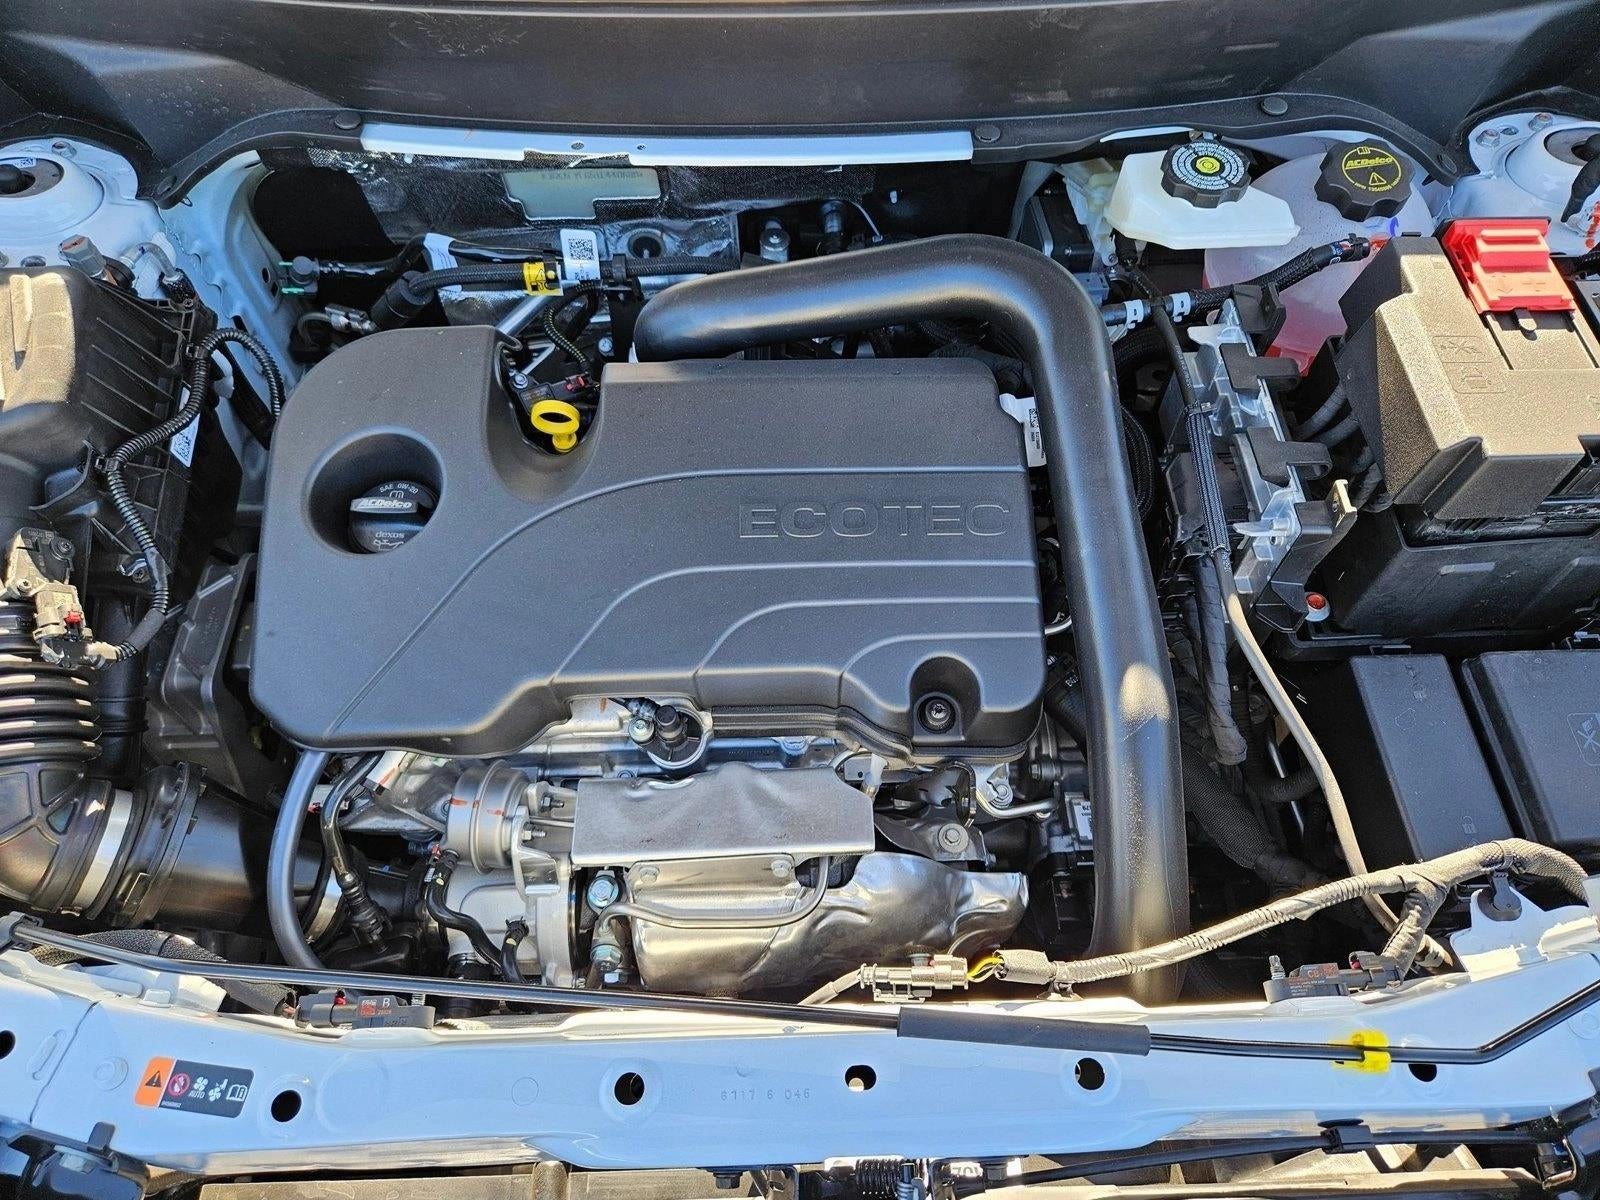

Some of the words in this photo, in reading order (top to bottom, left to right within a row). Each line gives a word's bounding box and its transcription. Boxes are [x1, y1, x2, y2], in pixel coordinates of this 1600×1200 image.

[1345, 156, 1394, 168] ACDelco
[379, 483, 394, 493] SAE
[357, 499, 412, 508] ACDelco
[738, 501, 1010, 538] ECOTEC
